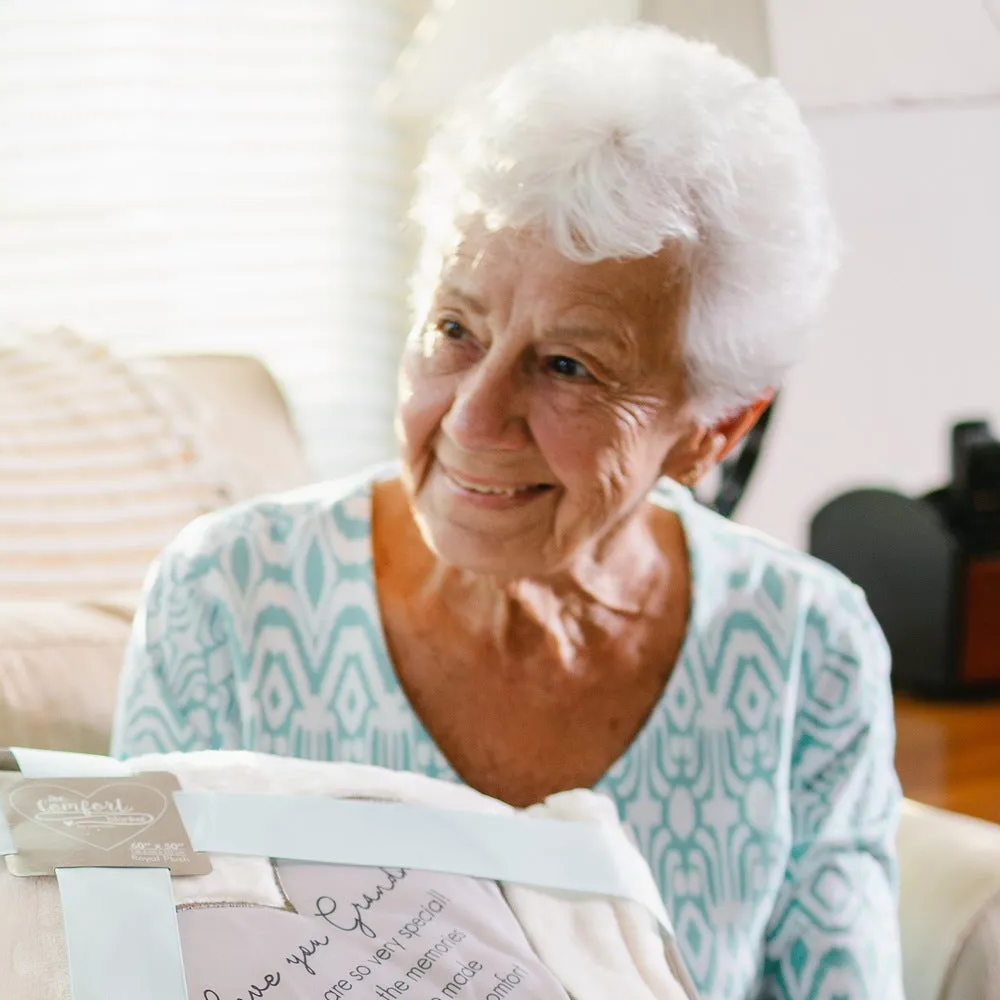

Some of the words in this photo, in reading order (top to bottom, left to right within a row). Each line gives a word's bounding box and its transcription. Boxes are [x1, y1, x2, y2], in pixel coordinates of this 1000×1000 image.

[37, 799, 126, 817] Comfort
[286, 935, 329, 976] you
[350, 964, 371, 982] so
[367, 936, 406, 967] very
[406, 927, 467, 983] memories
[442, 958, 483, 1000] made
